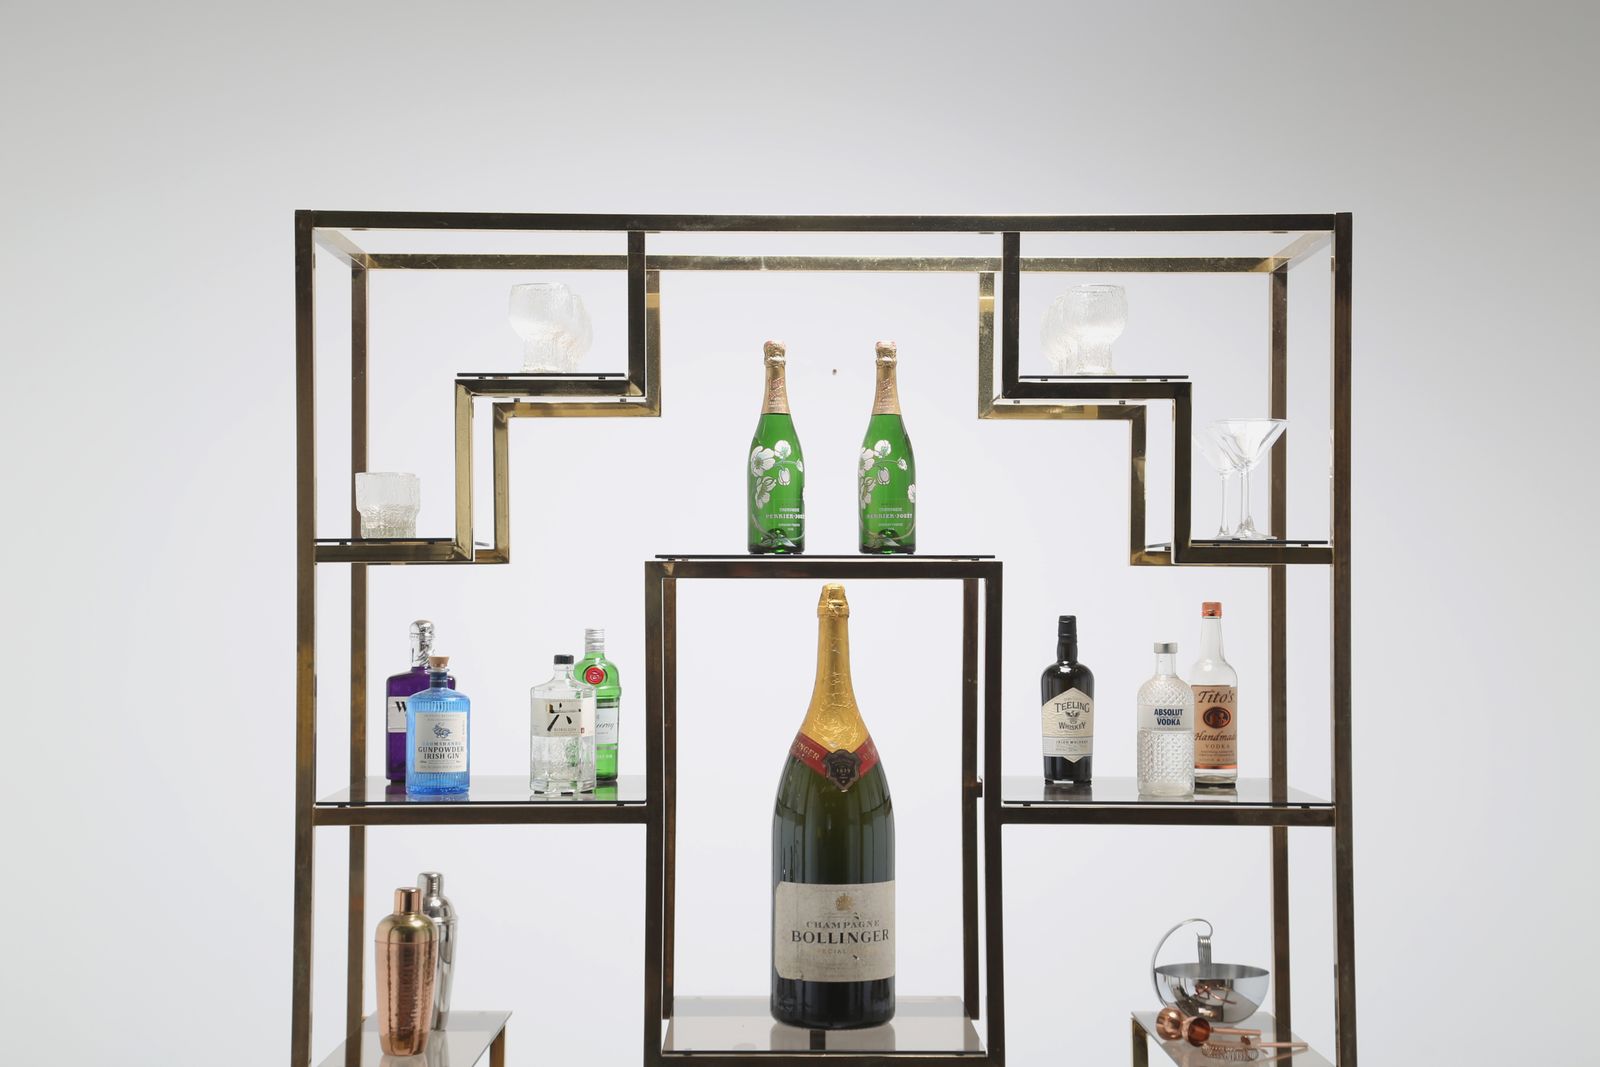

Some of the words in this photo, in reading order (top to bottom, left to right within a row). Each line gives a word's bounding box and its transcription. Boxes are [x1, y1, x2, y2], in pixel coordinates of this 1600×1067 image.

[1198, 690, 1235, 704] Tito's
[1054, 701, 1090, 713] TEELING
[1154, 708, 1184, 716] ABSOLUT
[1156, 718, 1181, 726] VODKA
[806, 920, 880, 929] CHAMPAGNE
[791, 929, 889, 944] BOLLINGER
